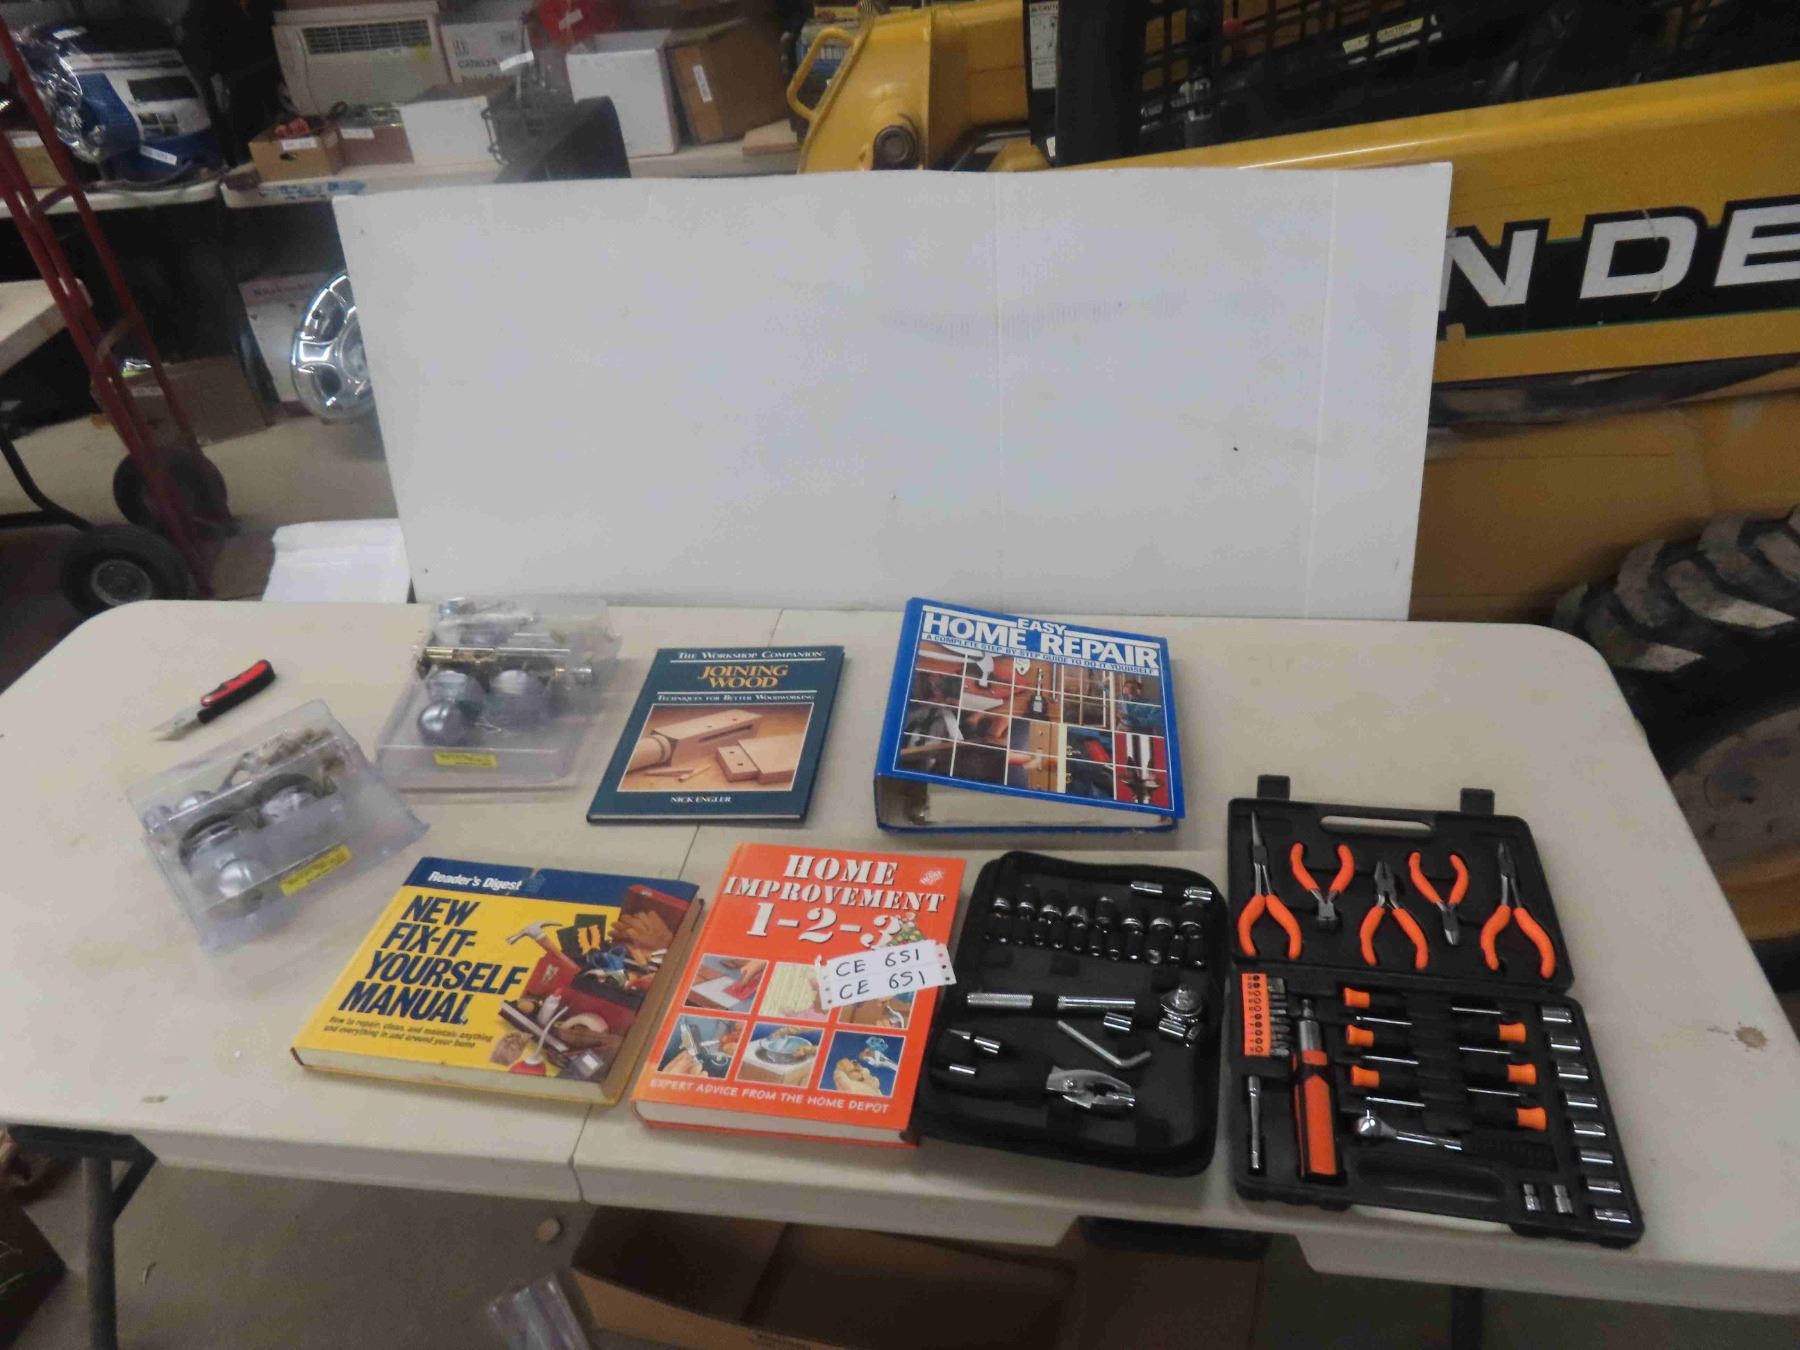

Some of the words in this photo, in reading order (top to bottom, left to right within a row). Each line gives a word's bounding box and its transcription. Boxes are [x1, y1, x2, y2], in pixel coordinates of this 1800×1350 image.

[923, 610, 1027, 649] HOME
[1040, 632, 1160, 668] REPAIR
[1018, 618, 1066, 635] EASY
[699, 651, 758, 660] WORKSHOP
[761, 650, 823, 659] COMPANION
[701, 665, 788, 678] JOINING
[710, 677, 778, 688] WOOD
[428, 870, 482, 888] Reader's
[483, 876, 524, 892] Digest
[783, 854, 899, 887] HOME
[722, 876, 945, 913] IMPROVEMENT
[400, 895, 481, 926] NEW
[365, 950, 529, 996] YOURSELF
[835, 959, 867, 978] CE
[885, 949, 920, 967] 651
[839, 980, 871, 1000] CE
[888, 970, 926, 988] 651
[338, 981, 473, 1025] MANUAL
[650, 1078, 694, 1091] EXPERT
[696, 1083, 738, 1098] ADVICE
[742, 1087, 776, 1101] FROM
[780, 1092, 804, 1105] THE
[808, 1095, 845, 1108] HOME
[848, 1099, 890, 1114] DEPOT
